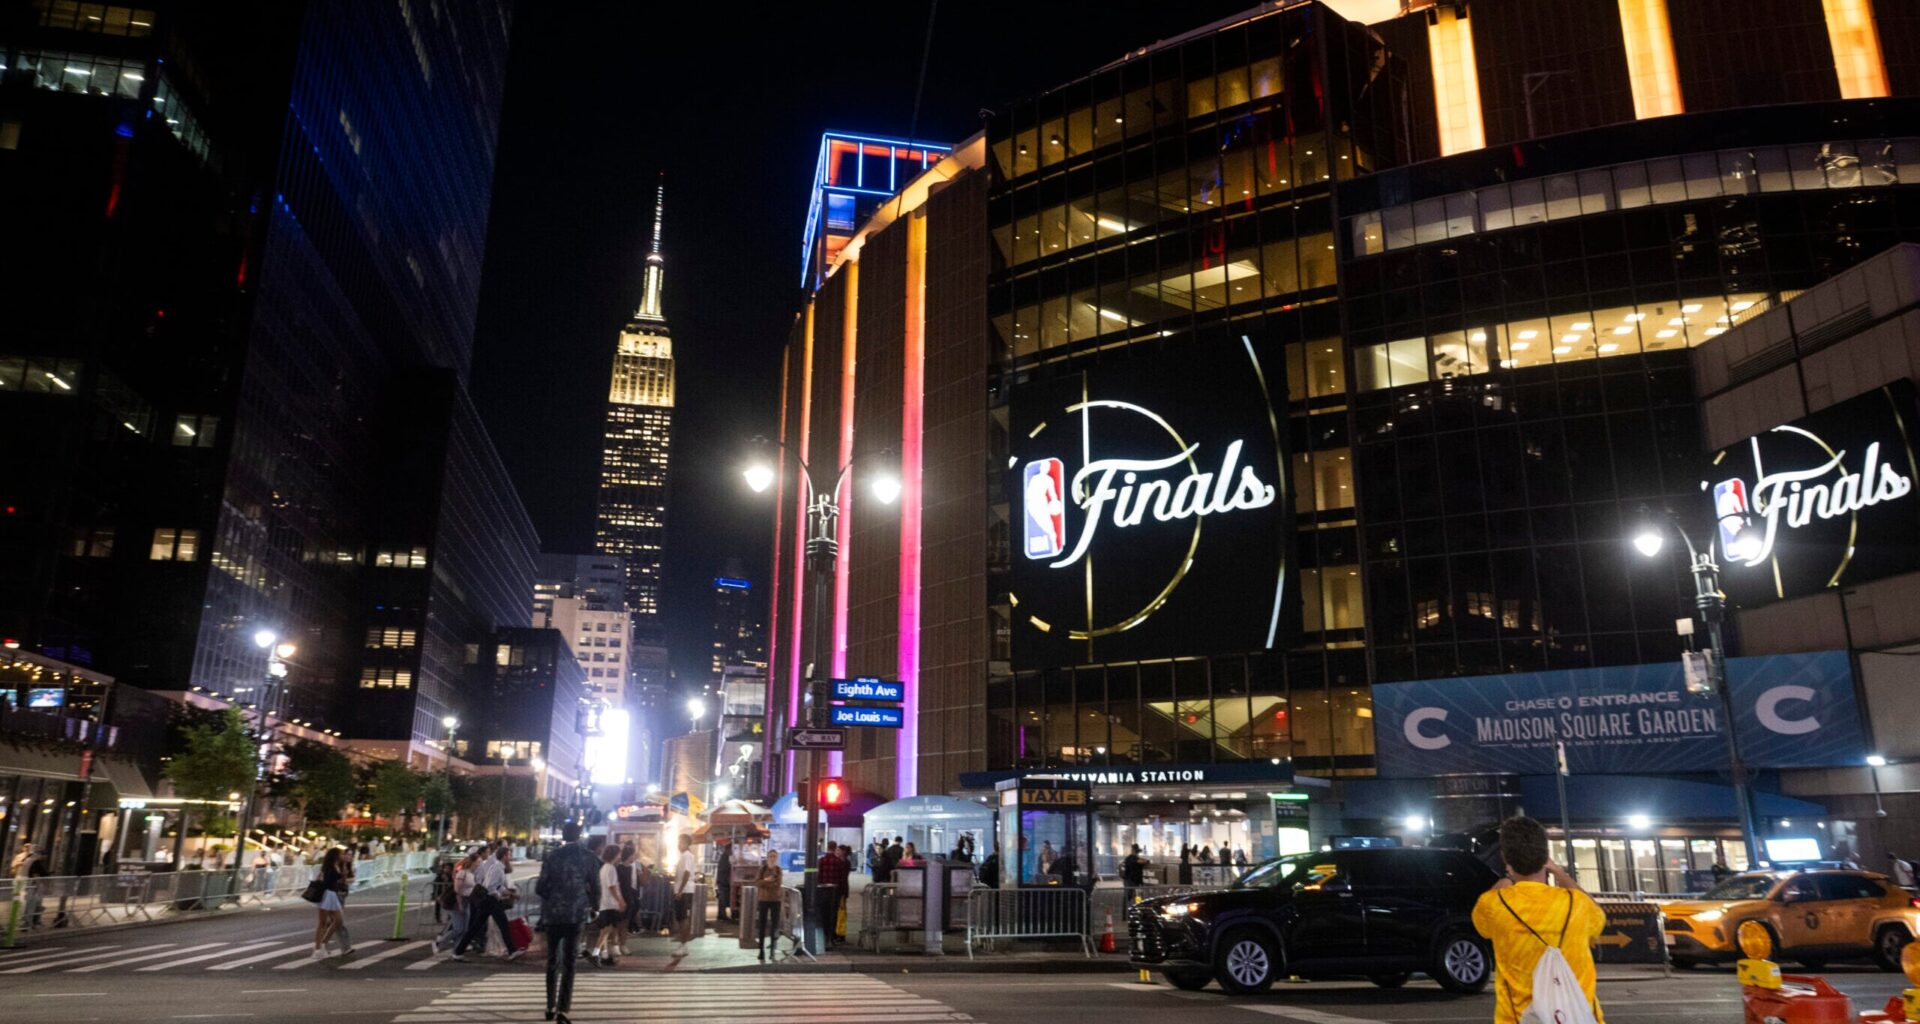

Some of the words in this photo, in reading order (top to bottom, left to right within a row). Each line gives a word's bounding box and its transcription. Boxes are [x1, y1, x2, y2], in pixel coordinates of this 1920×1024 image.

[1050, 439, 1275, 568] Finals
[1744, 442, 1911, 567] Finals
[838, 683, 873, 697] Eighth
[875, 685, 898, 696] Ave
[1505, 699, 1556, 711] CHASE
[1578, 691, 1680, 706] ENTRANCE
[1755, 685, 1822, 735] C
[837, 710, 854, 721] Joe
[855, 711, 881, 722] Louis
[1476, 716, 1555, 742] MADISON
[1561, 712, 1633, 739] SQUARE
[1638, 708, 1717, 735] GARDEN
[800, 734, 815, 742] ONE
[820, 734, 837, 742] WAY
[1403, 706, 1452, 750] C
[1141, 770, 1204, 782] STATION
[1026, 790, 1064, 803] TAXI
